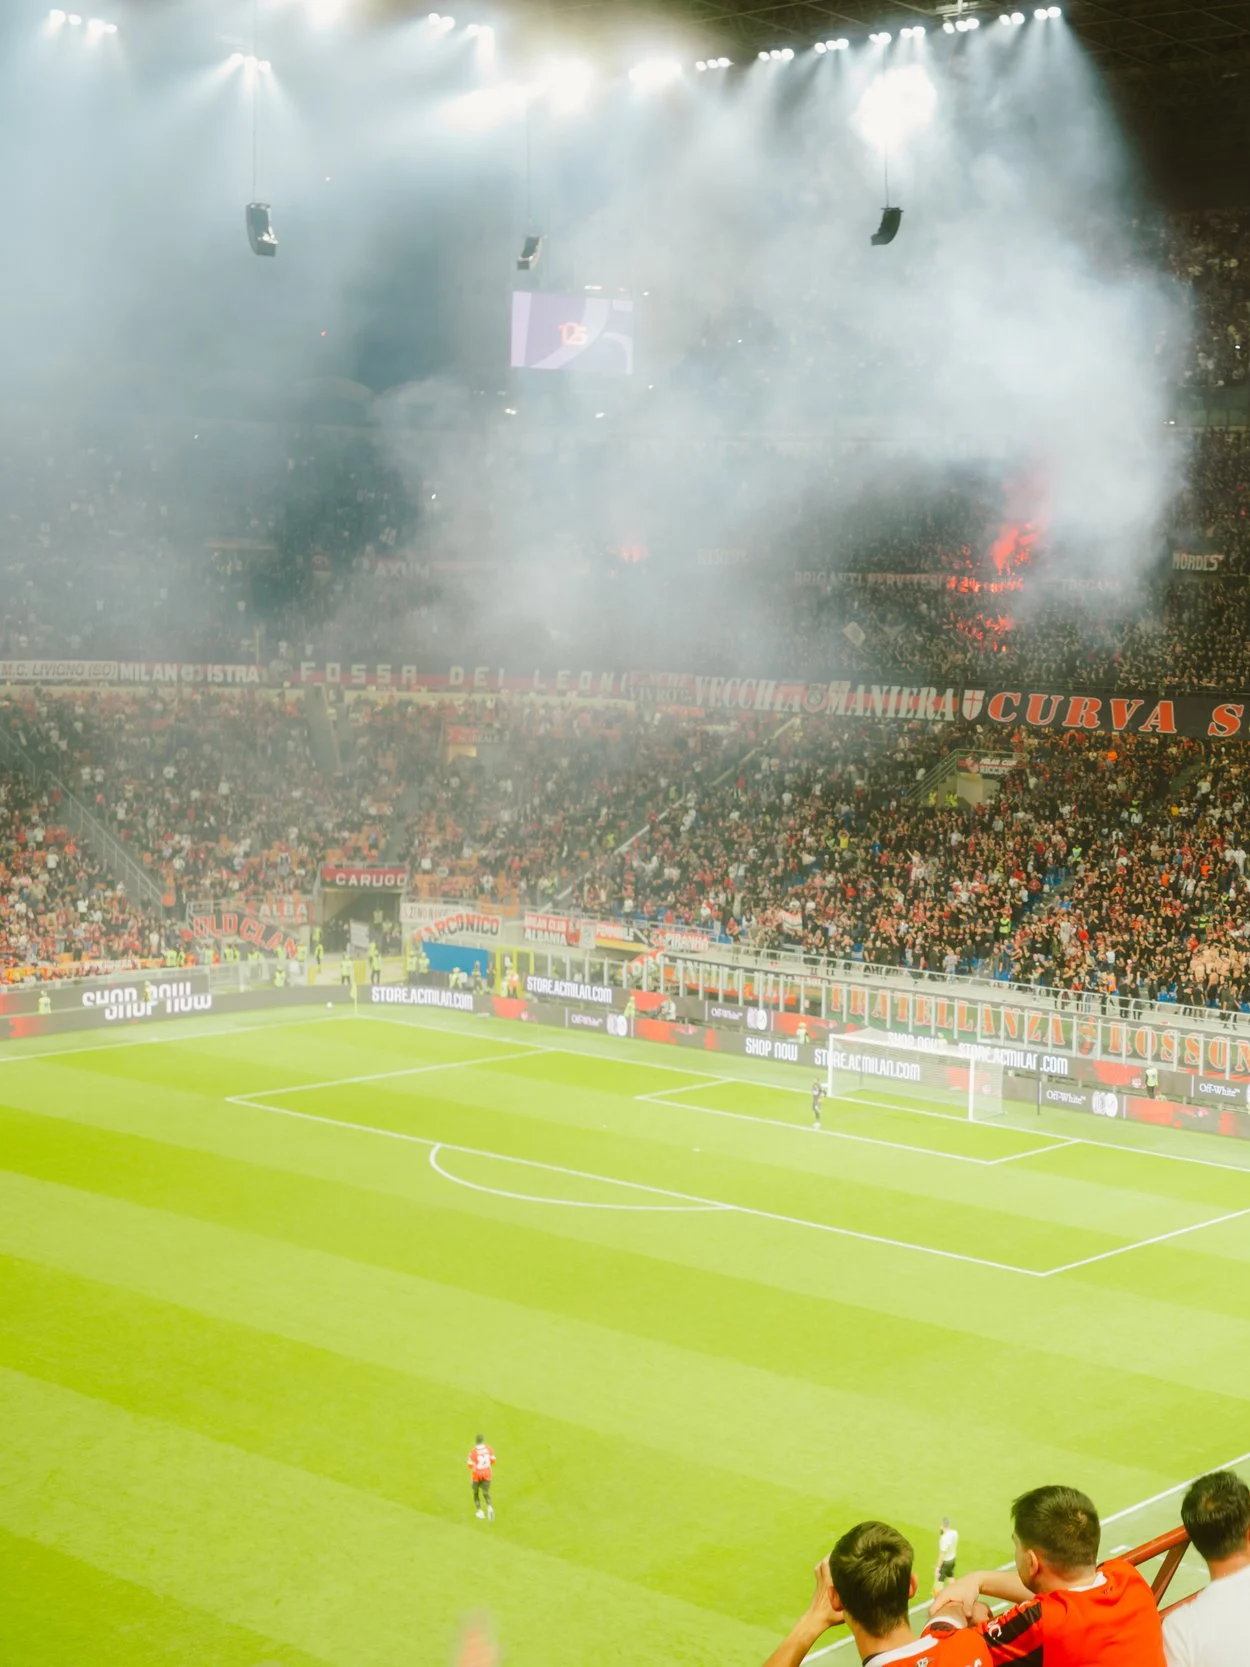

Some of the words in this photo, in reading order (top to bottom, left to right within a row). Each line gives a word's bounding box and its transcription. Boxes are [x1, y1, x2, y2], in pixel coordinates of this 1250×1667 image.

[120, 661, 177, 682] MILAN
[207, 663, 260, 683] ISTRA
[299, 662, 418, 685] FOSSA
[448, 665, 505, 687] DEI
[826, 681, 957, 721] MANIERA
[986, 689, 1179, 735] CURVA
[371, 985, 474, 1011] STORE.ACMILAN.COM
[745, 1039, 772, 1058] SHOP
